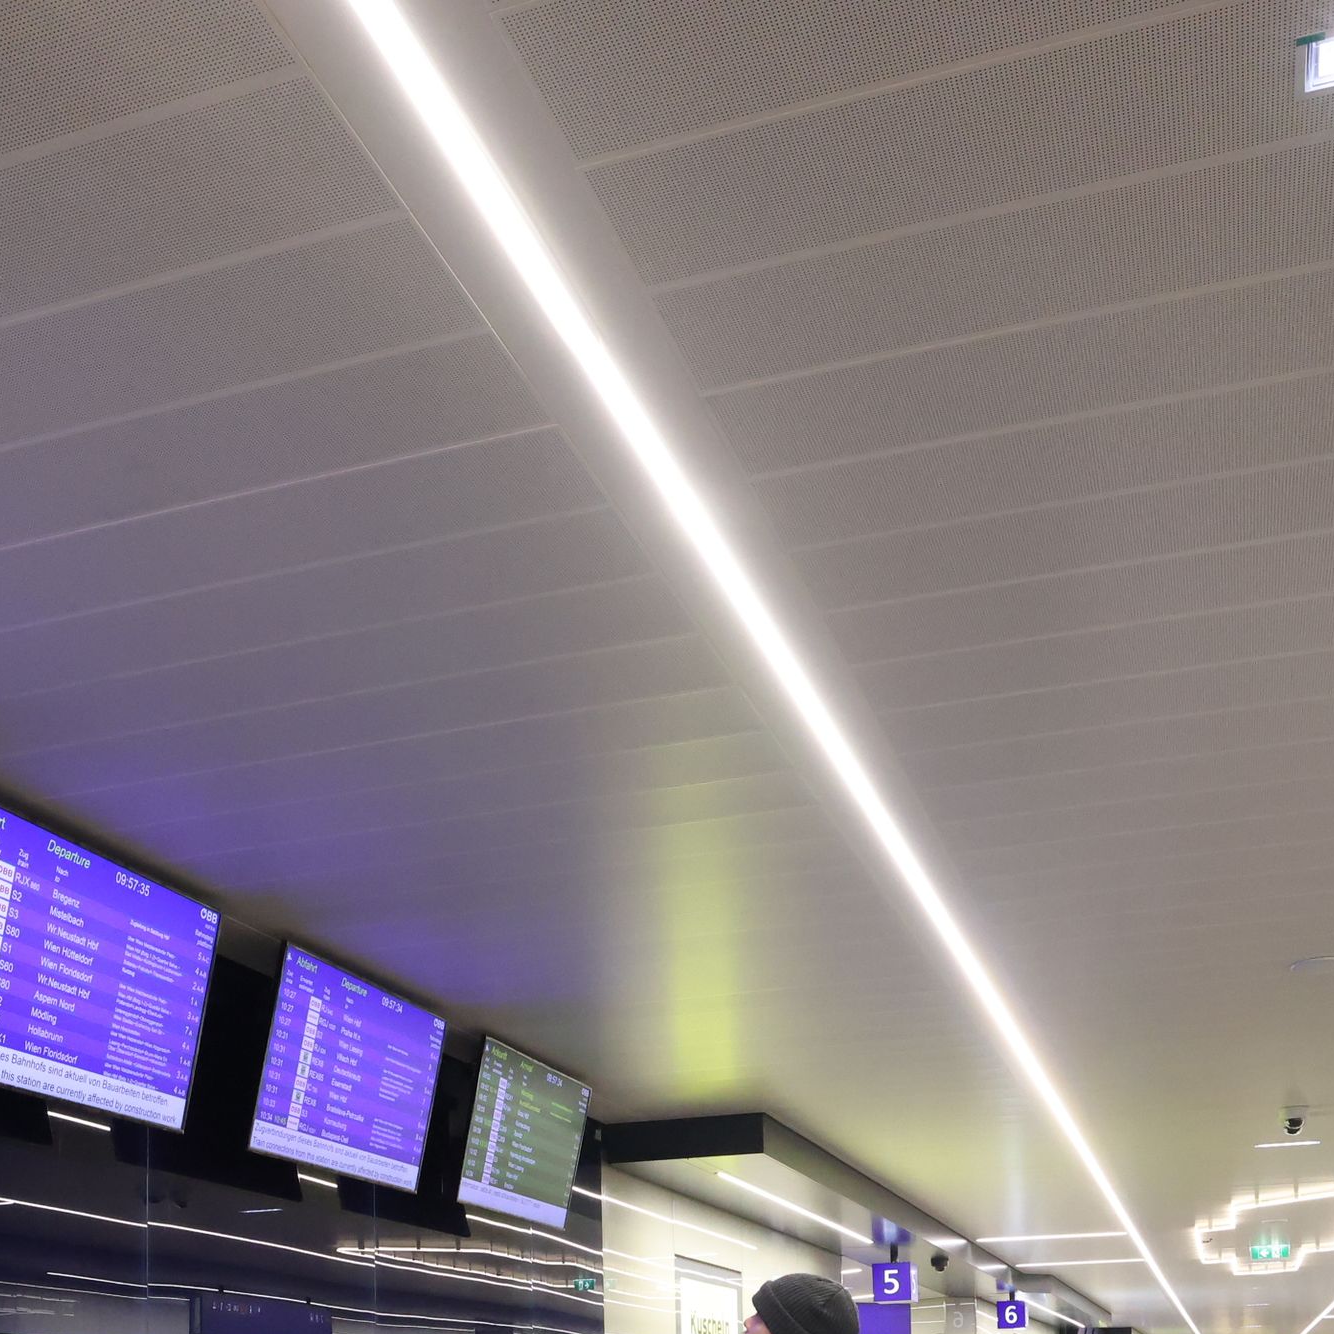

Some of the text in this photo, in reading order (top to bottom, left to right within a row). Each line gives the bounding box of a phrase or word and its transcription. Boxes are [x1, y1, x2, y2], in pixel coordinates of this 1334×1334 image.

[46, 838, 91, 869] Departure
[115, 871, 150, 896] 09:57:35
[200, 907, 217, 924] ÖBB
[11, 889, 22, 902] S2
[49, 905, 84, 927] Mistelbach
[883, 1269, 900, 1295] 5
[1004, 1305, 1018, 1324] 6
